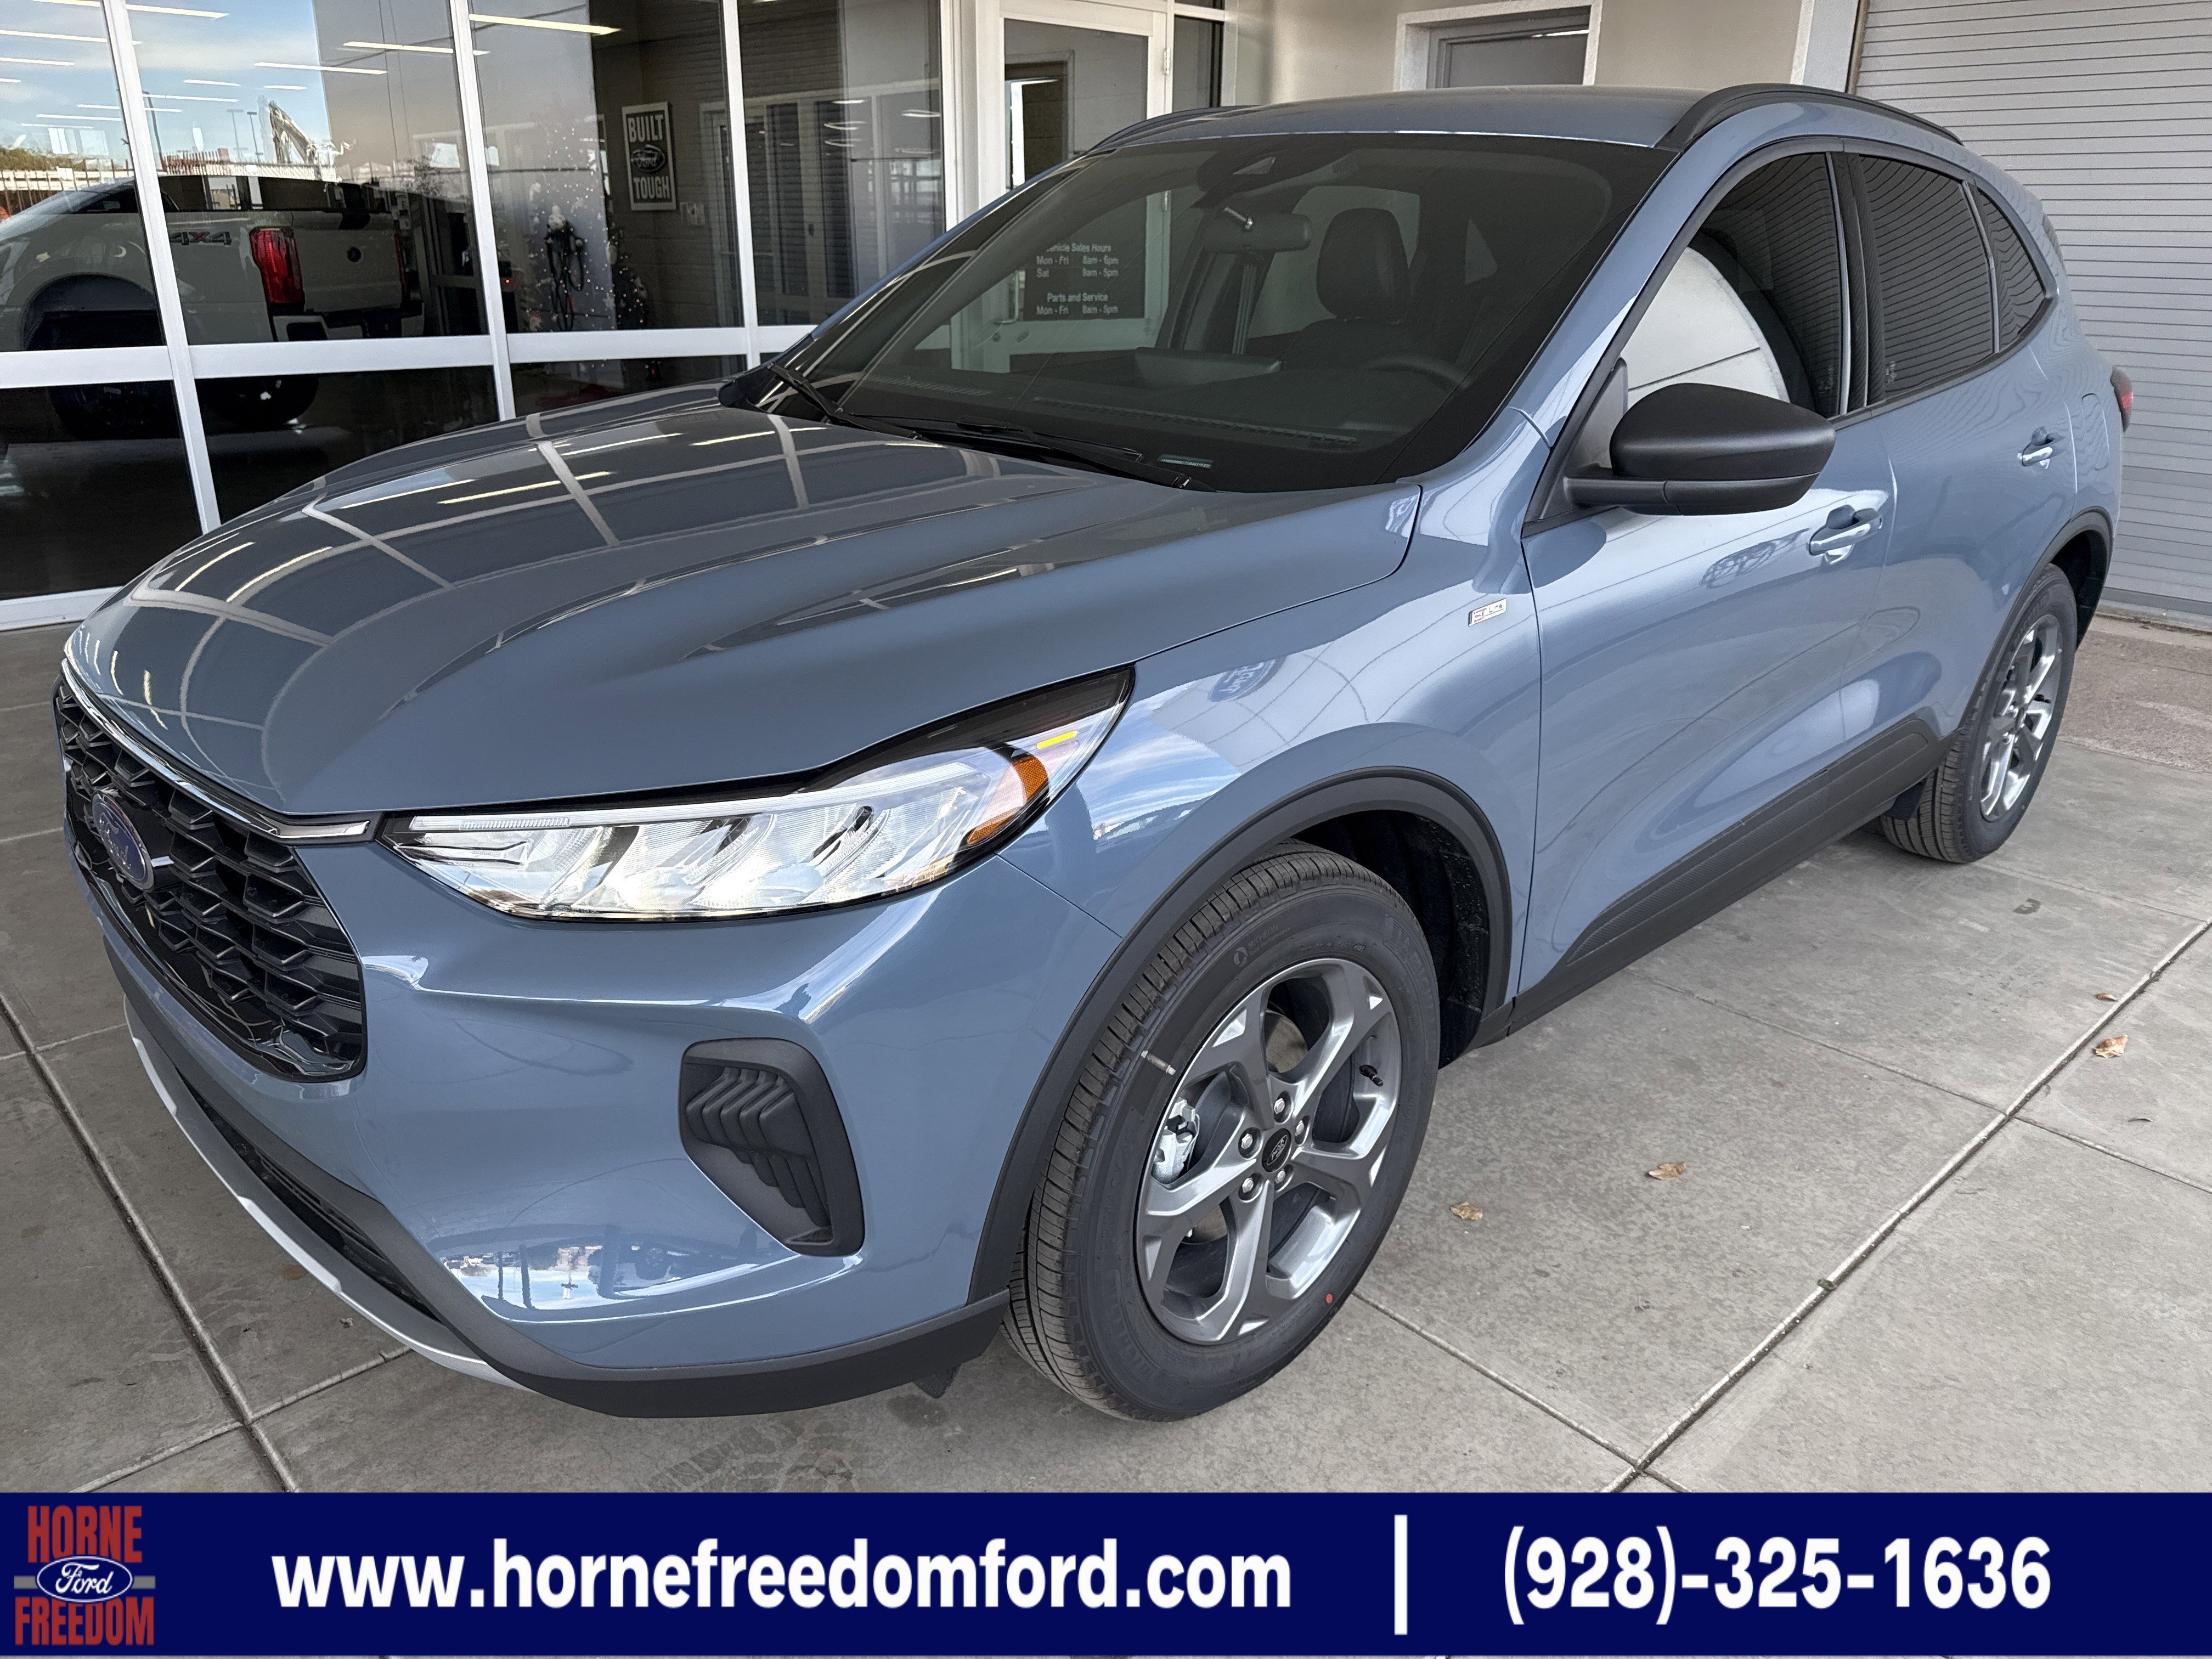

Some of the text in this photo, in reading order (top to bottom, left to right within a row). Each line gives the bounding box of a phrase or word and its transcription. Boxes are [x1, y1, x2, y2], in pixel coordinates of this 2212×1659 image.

[628, 114, 664, 143] BUILT
[633, 176, 670, 200] TOUGH
[1071, 243, 1090, 252] Sales
[1091, 244, 1111, 252] Hours
[1036, 256, 1053, 264] Mon
[1059, 256, 1069, 264] Fri
[1037, 268, 1049, 278] Sat
[1047, 292, 1108, 302] Parts and Service
[1036, 306, 1053, 314] Mon
[1059, 306, 1069, 314] Fri
